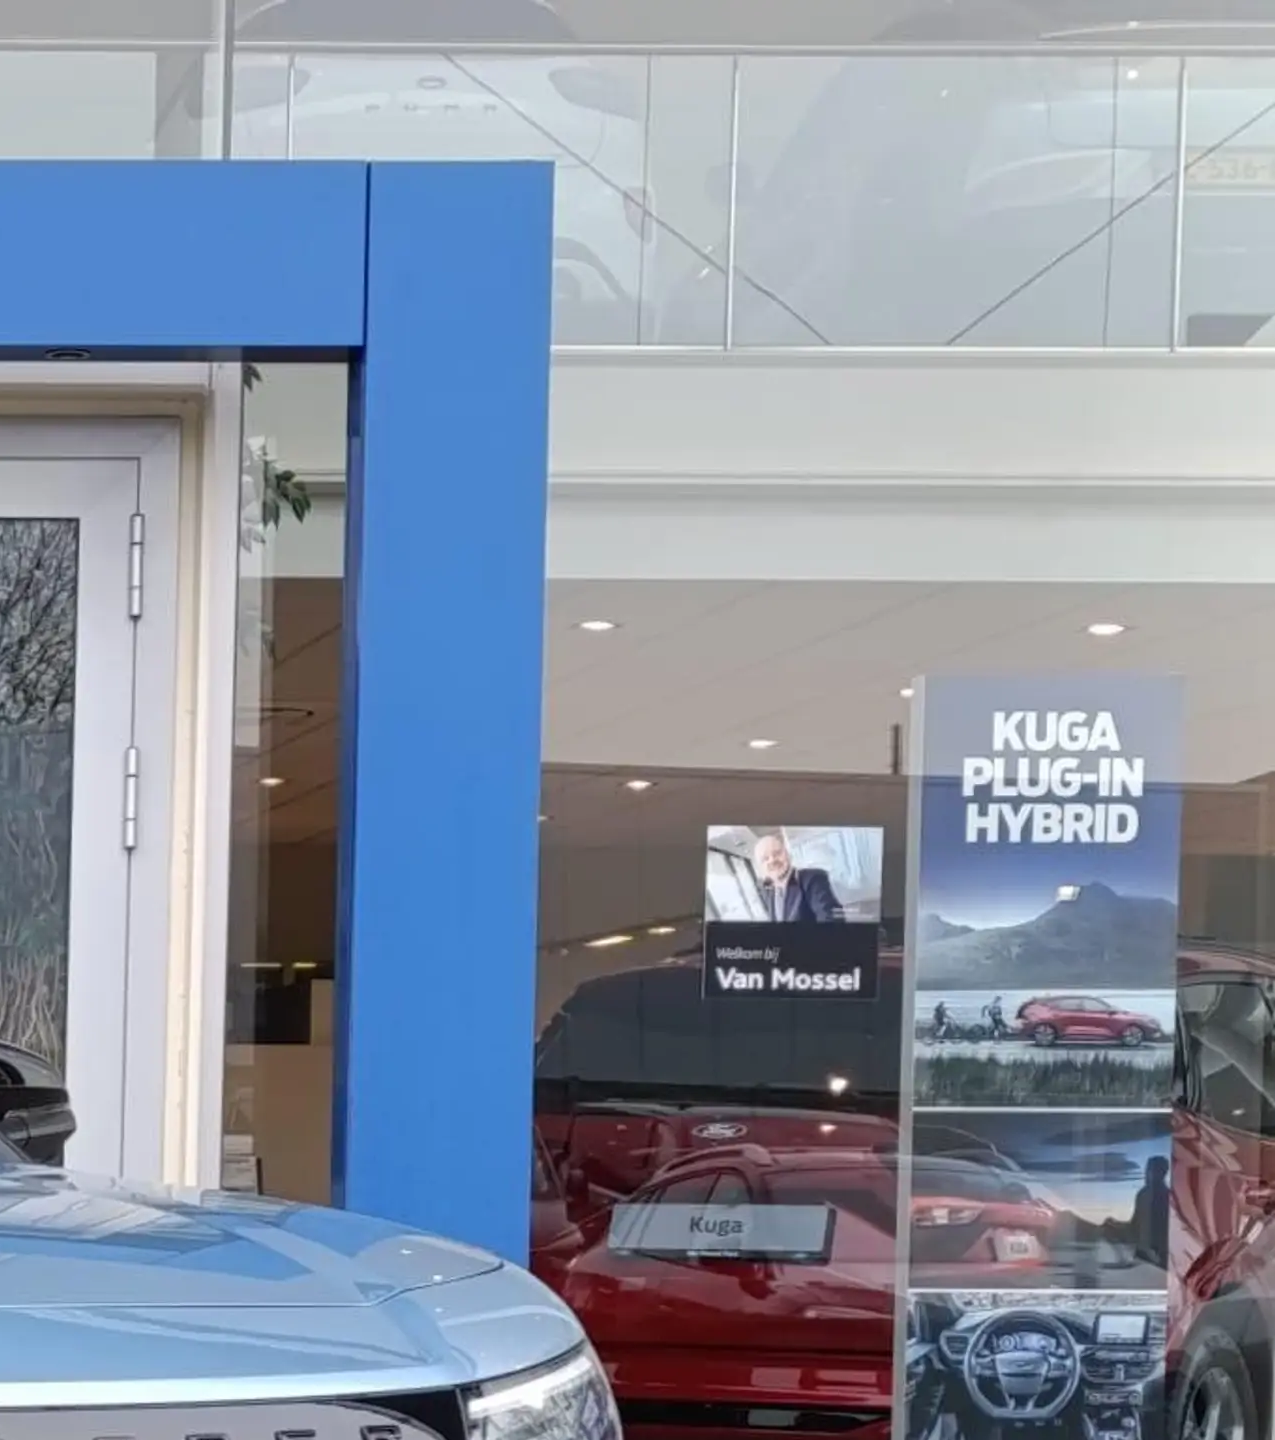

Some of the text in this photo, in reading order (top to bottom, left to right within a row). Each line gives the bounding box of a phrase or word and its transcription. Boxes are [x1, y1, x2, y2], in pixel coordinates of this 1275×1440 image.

[992, 711, 1121, 752] KUGA
[962, 756, 1144, 797] PLUG-IN
[965, 802, 1140, 844] HYBRID
[715, 966, 861, 991] Van Mossel
[689, 1216, 743, 1237] Kuga
